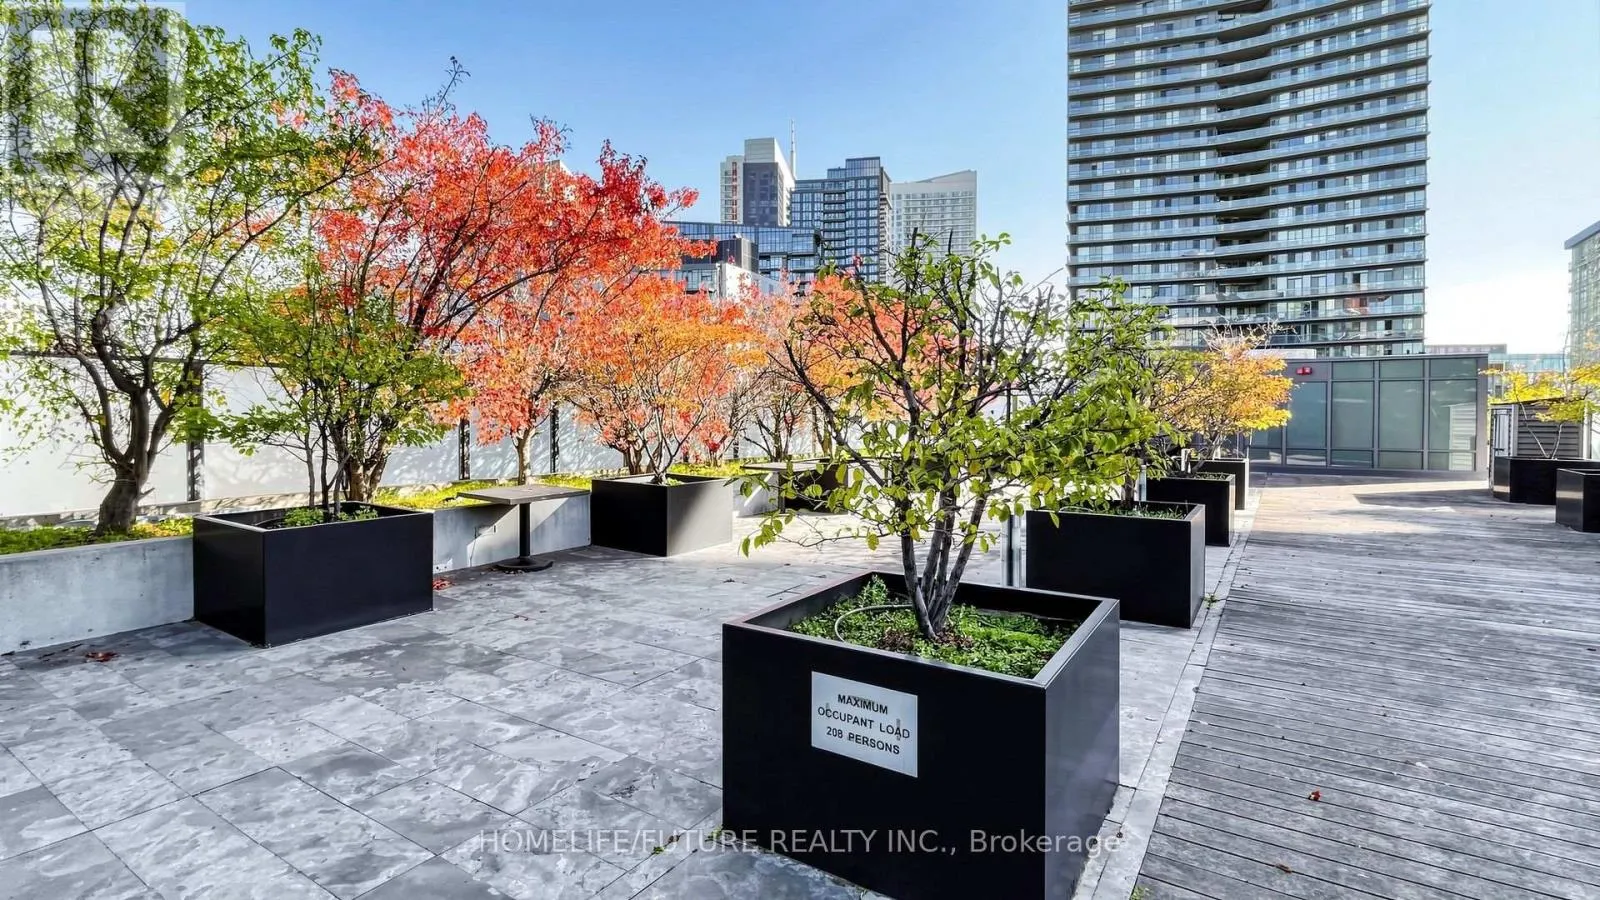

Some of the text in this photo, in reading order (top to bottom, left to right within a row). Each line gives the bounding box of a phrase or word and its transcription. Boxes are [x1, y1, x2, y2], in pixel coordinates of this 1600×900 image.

[838, 694, 888, 715] MAXIMUM
[818, 706, 910, 739] OCCUPANT LOAD
[826, 726, 900, 755] 208 PERSONS
